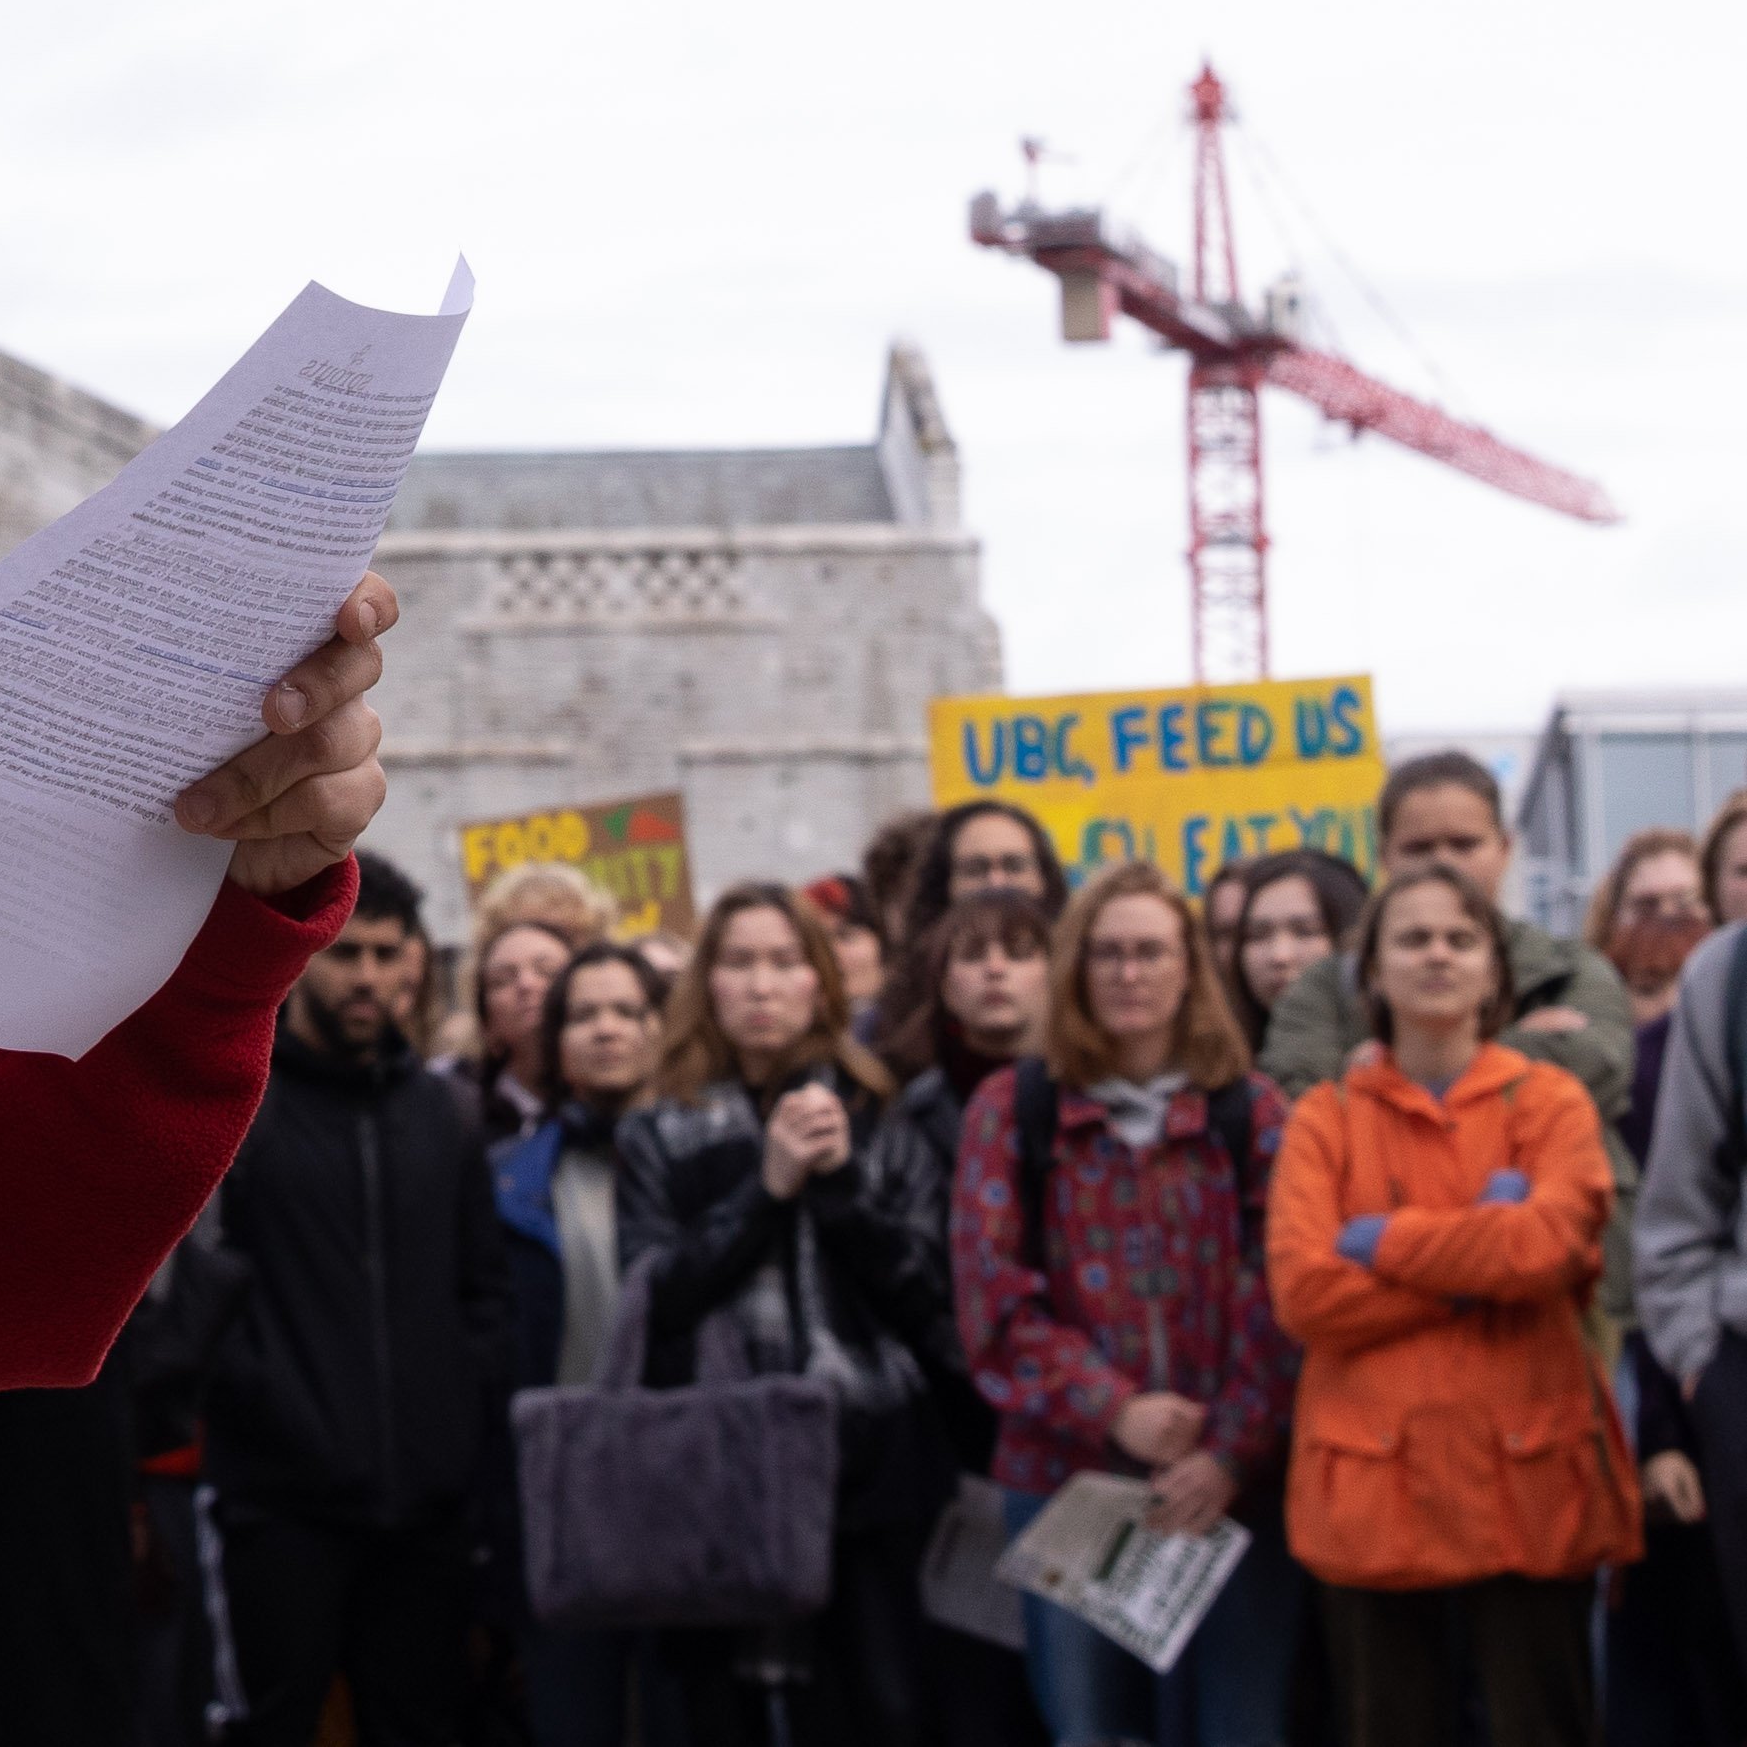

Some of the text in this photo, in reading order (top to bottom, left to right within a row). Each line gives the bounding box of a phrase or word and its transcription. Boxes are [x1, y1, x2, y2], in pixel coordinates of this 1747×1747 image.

[961, 685, 1364, 787] UBC, FEED US
[462, 809, 589, 883] FOOD
